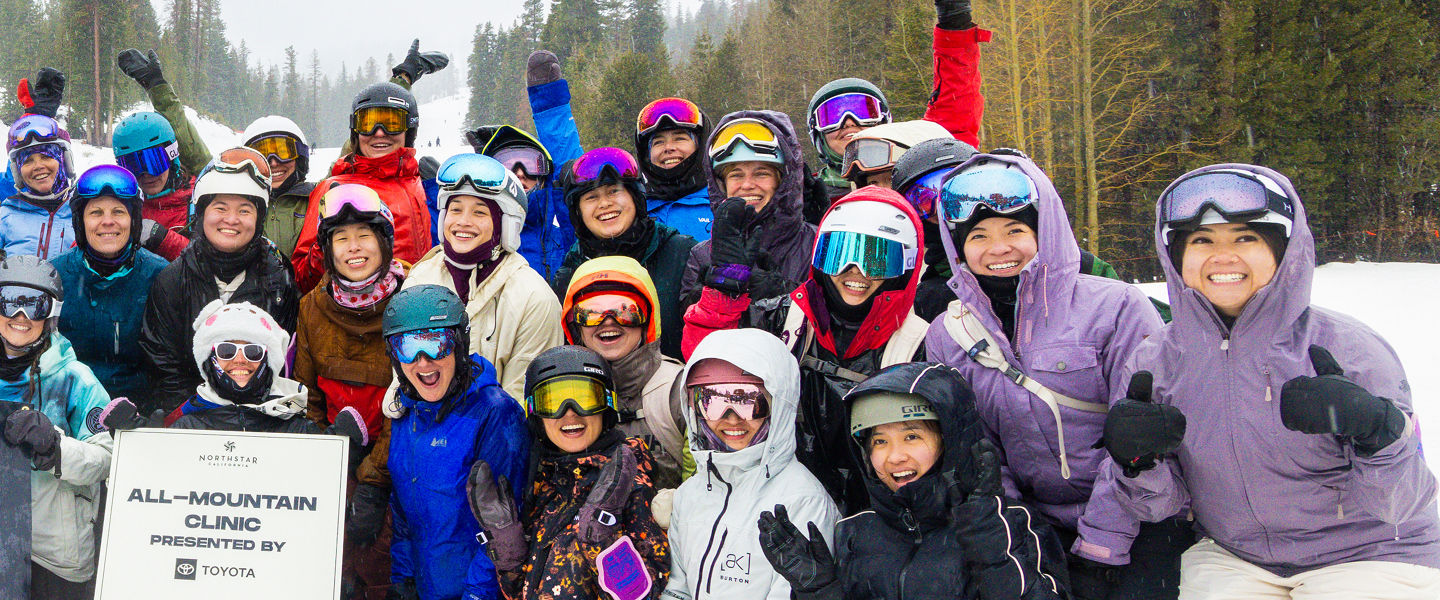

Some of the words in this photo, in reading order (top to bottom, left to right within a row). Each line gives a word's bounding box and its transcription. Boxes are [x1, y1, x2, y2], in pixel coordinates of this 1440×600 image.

[199, 454, 258, 464] NORTHSTAR
[184, 514, 261, 532] CLINIC
[150, 534, 255, 551] PRESENTED
[260, 540, 286, 552] BY
[202, 565, 256, 578] TOYOTA
[720, 575, 750, 584] BURTON
